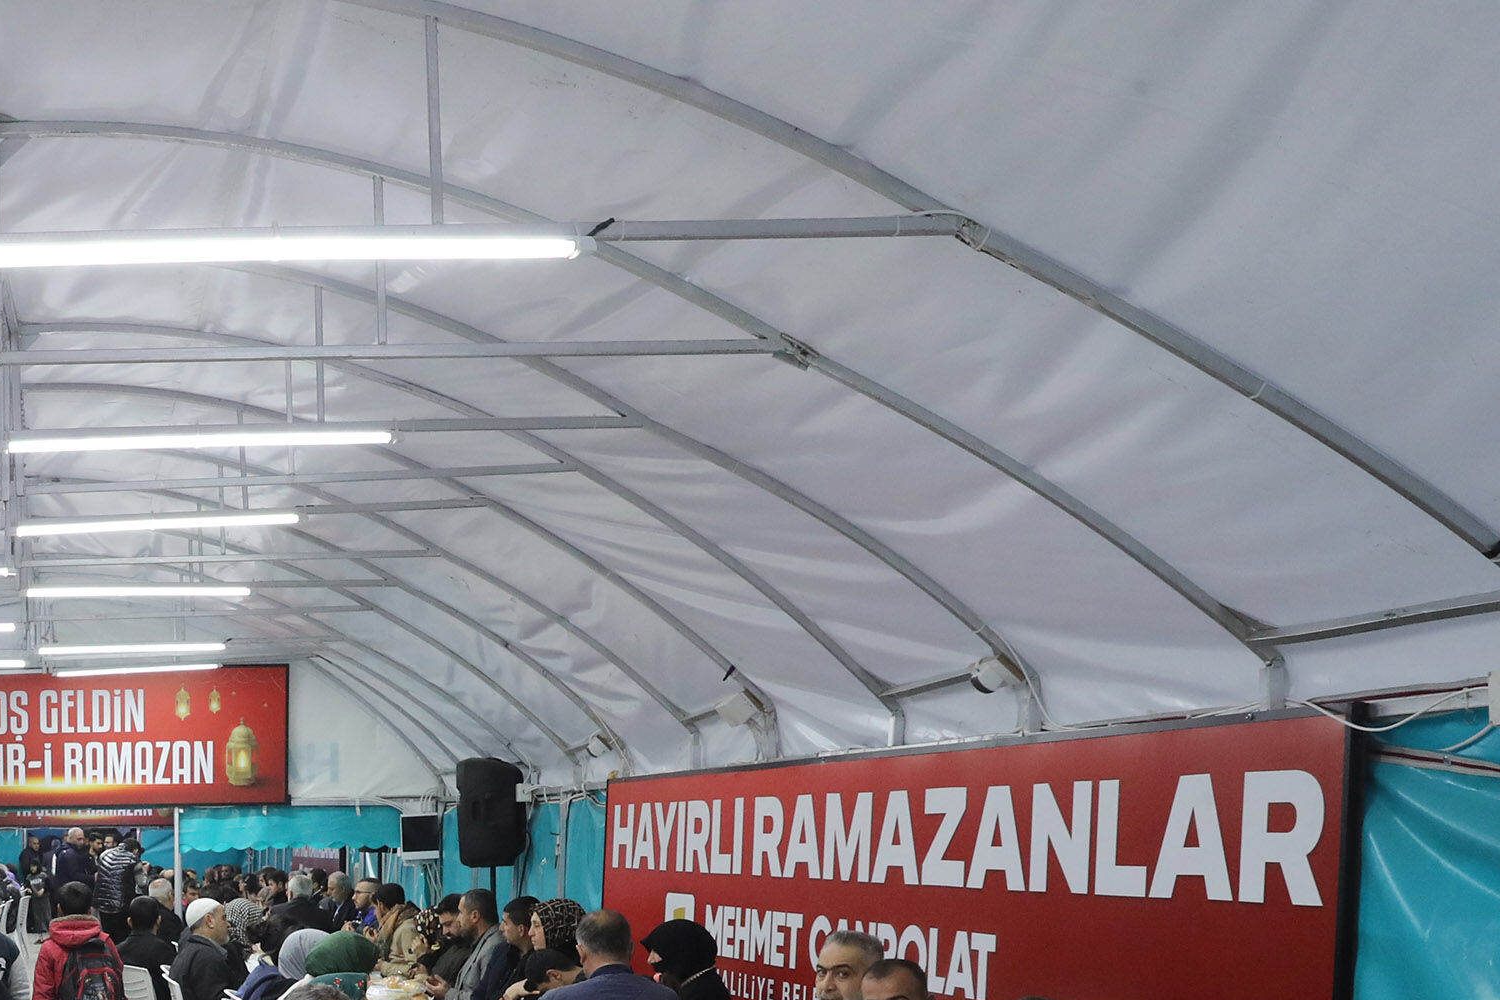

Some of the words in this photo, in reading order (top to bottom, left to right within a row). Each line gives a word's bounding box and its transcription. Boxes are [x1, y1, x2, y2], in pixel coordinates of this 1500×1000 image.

[63, 740, 214, 785] RAMAZAN
[612, 797, 744, 875] HAYIRLI
[751, 769, 1325, 907] RAMAZANLAR
[705, 904, 803, 969] MEHMET
